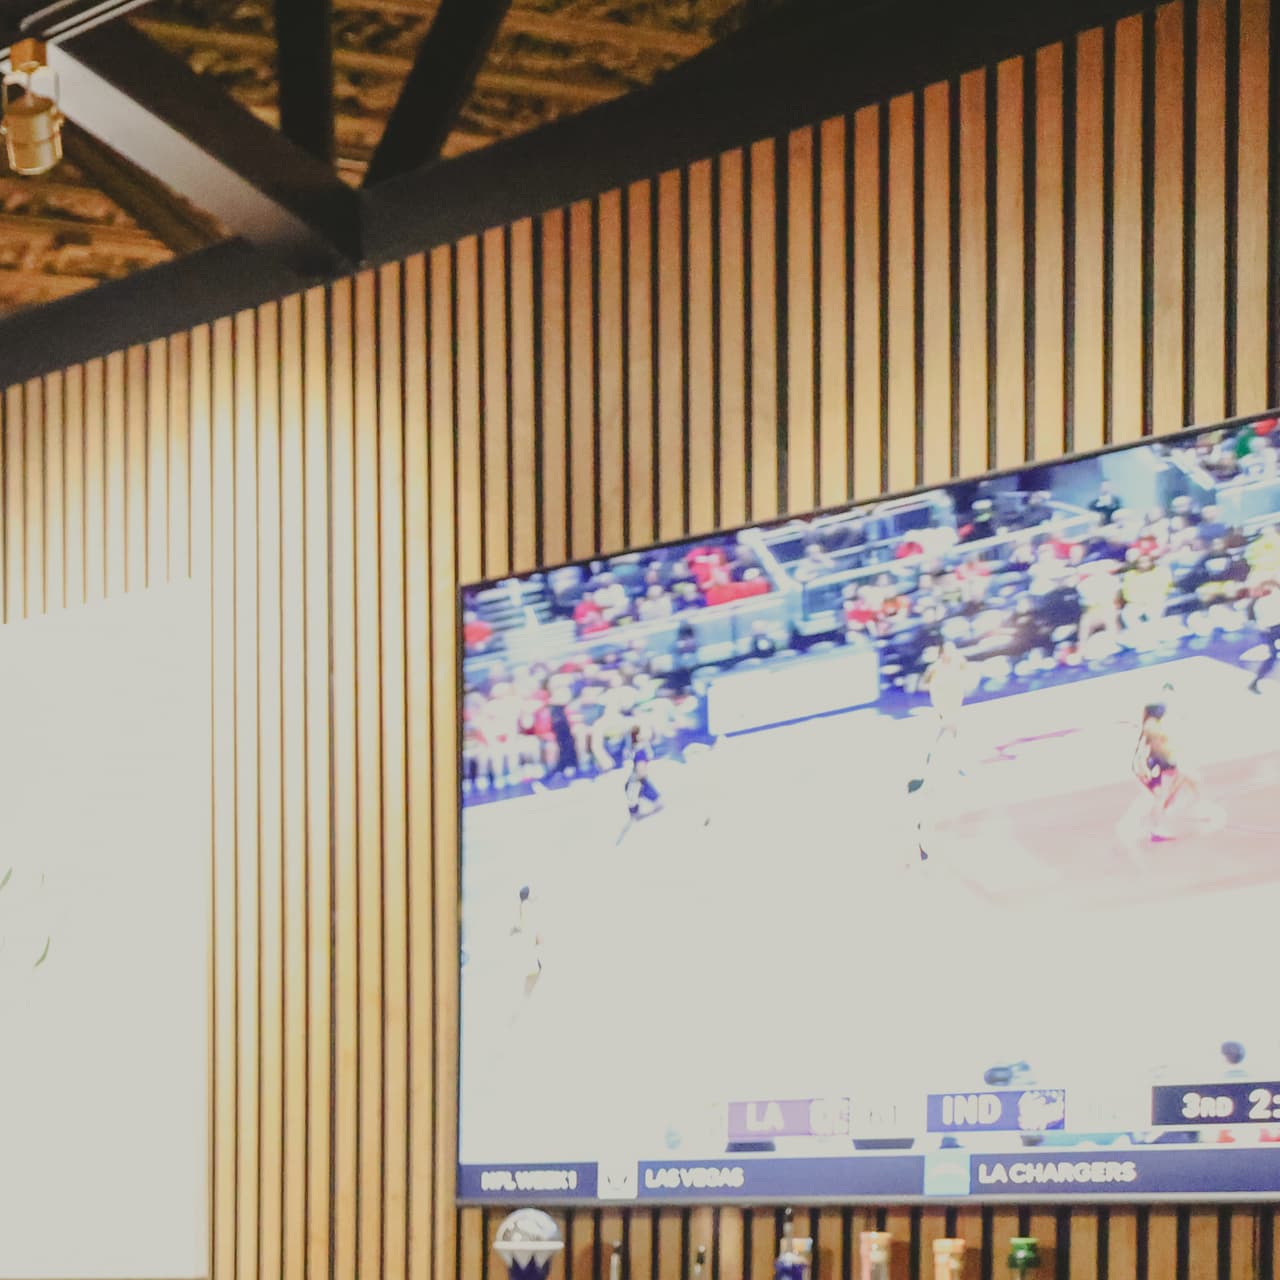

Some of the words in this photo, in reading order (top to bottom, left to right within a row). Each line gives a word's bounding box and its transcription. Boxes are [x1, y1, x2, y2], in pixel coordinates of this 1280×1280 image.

[745, 1102, 785, 1132] LA
[942, 1093, 1003, 1126] IND
[978, 1163, 1007, 1185] LA
[1008, 1161, 1138, 1184] CHARGERS
